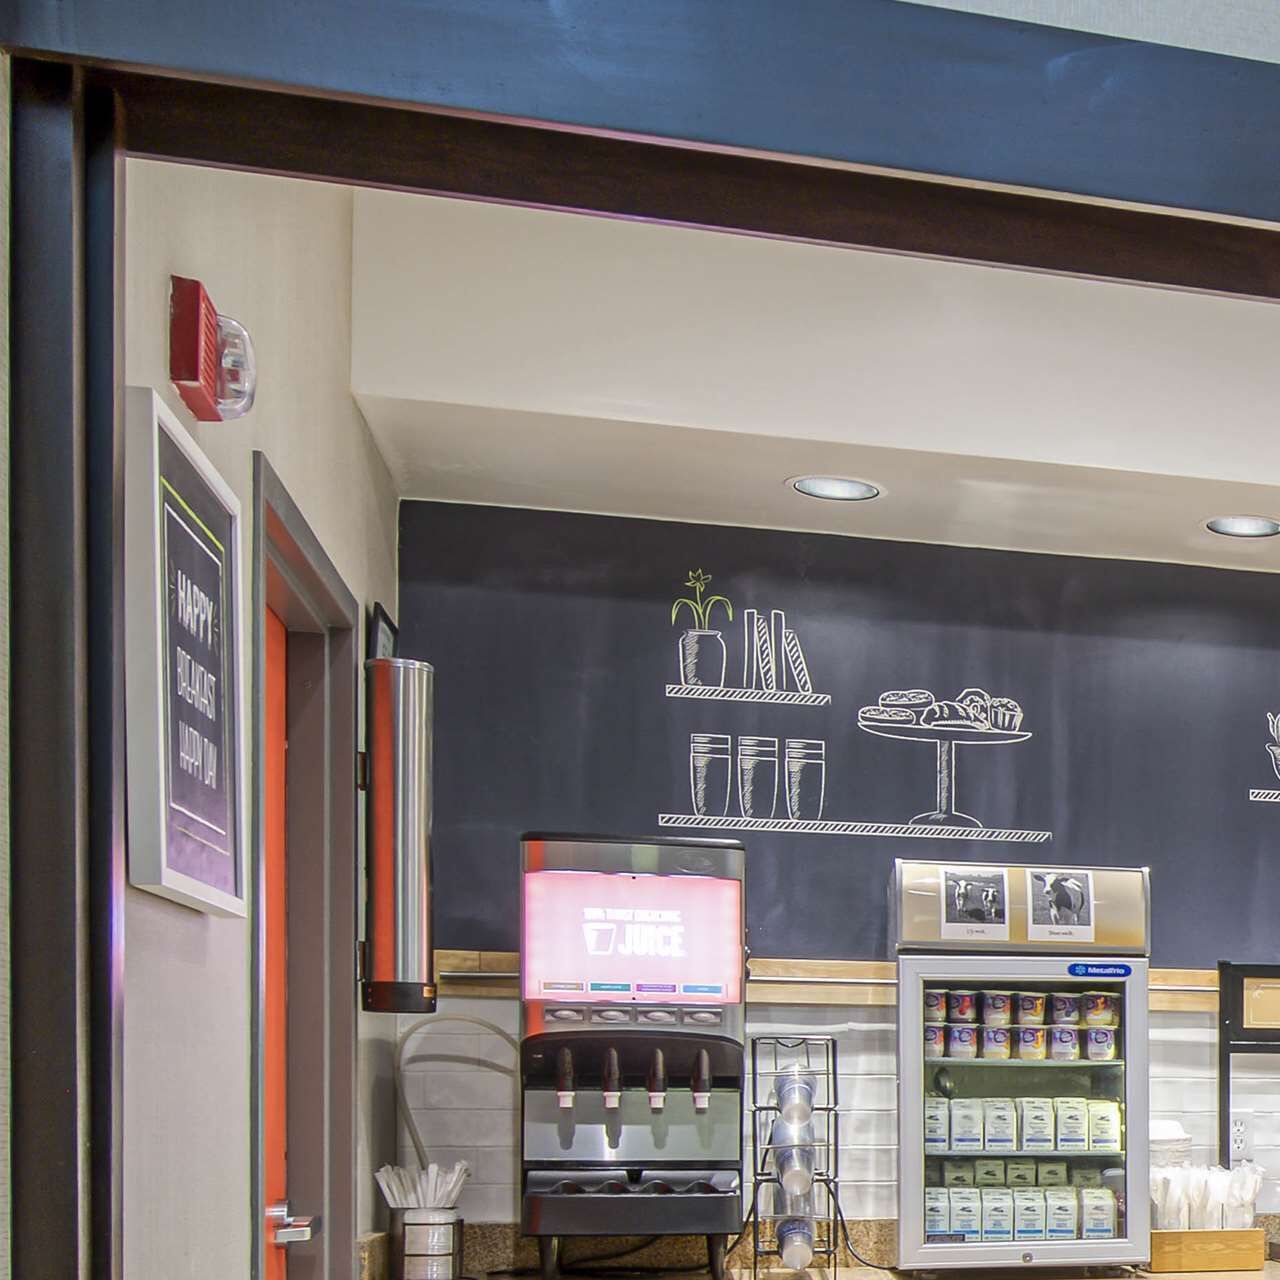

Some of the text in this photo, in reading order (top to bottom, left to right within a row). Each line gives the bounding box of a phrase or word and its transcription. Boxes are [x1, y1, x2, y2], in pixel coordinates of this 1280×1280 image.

[177, 569, 214, 650] HAPPY
[176, 646, 216, 722] BREAKFAST
[179, 719, 217, 790] HAPPY DAY
[617, 923, 685, 958] JUICE
